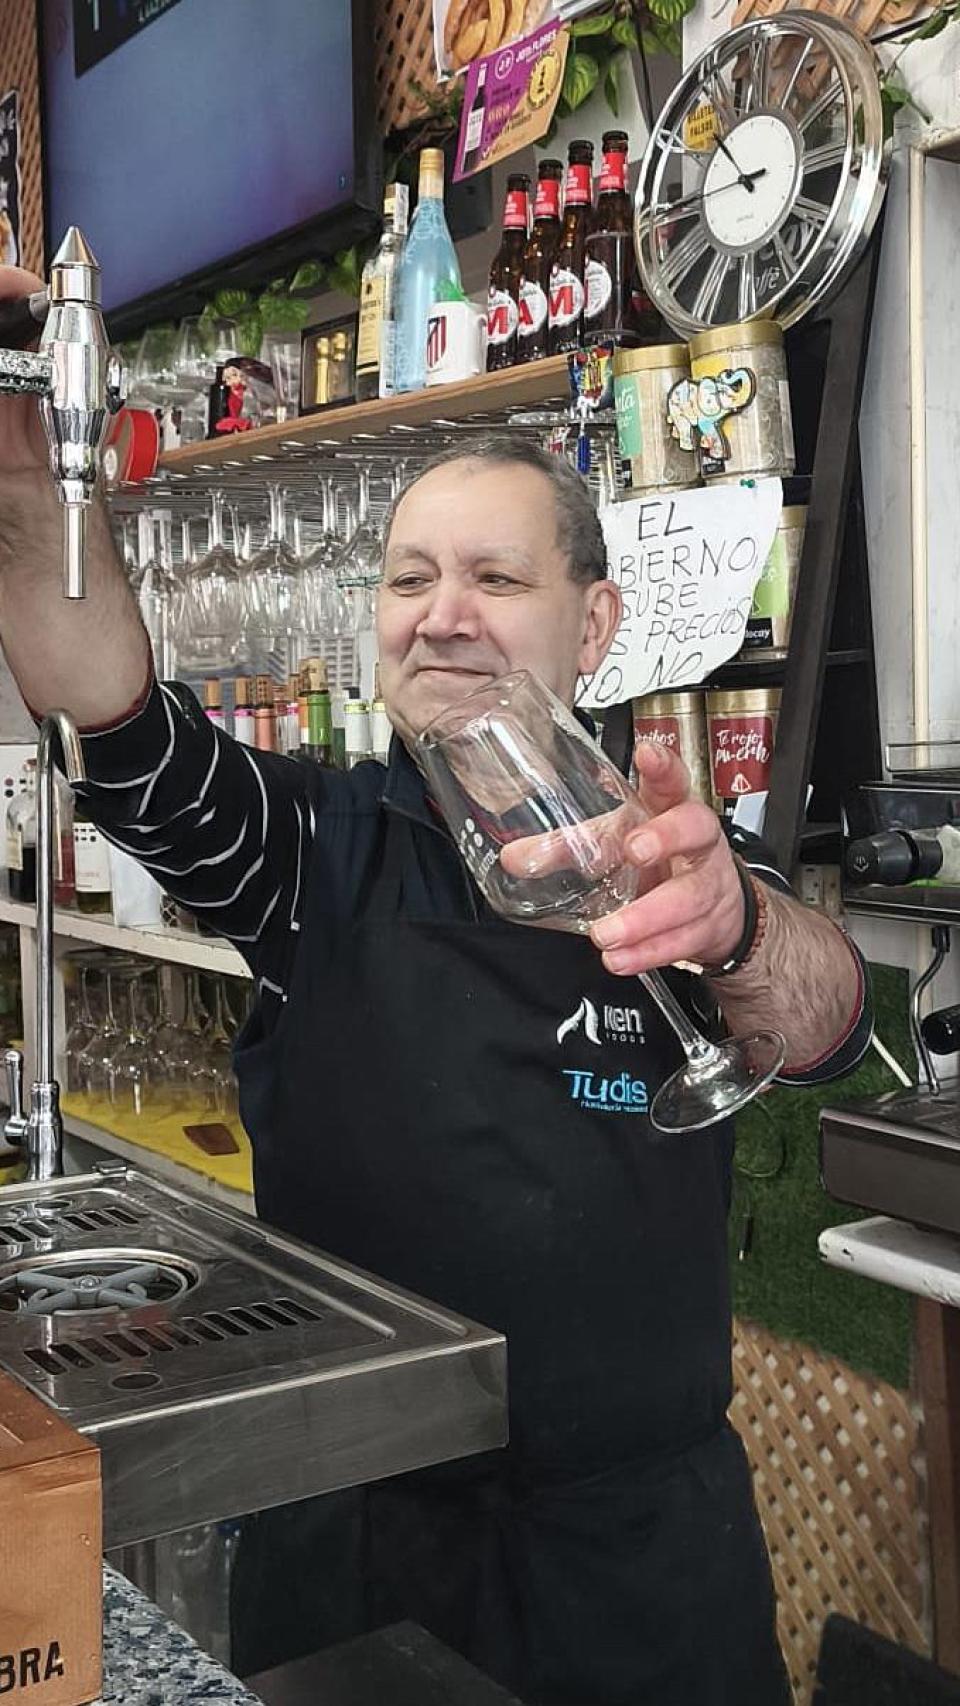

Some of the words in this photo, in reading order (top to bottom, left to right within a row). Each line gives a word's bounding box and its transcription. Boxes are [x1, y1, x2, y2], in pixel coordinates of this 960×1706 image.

[638, 501, 694, 541] EL
[645, 596, 752, 653] PRECIOS
[643, 651, 704, 691] NO
[561, 1069, 649, 1104] Tudis
